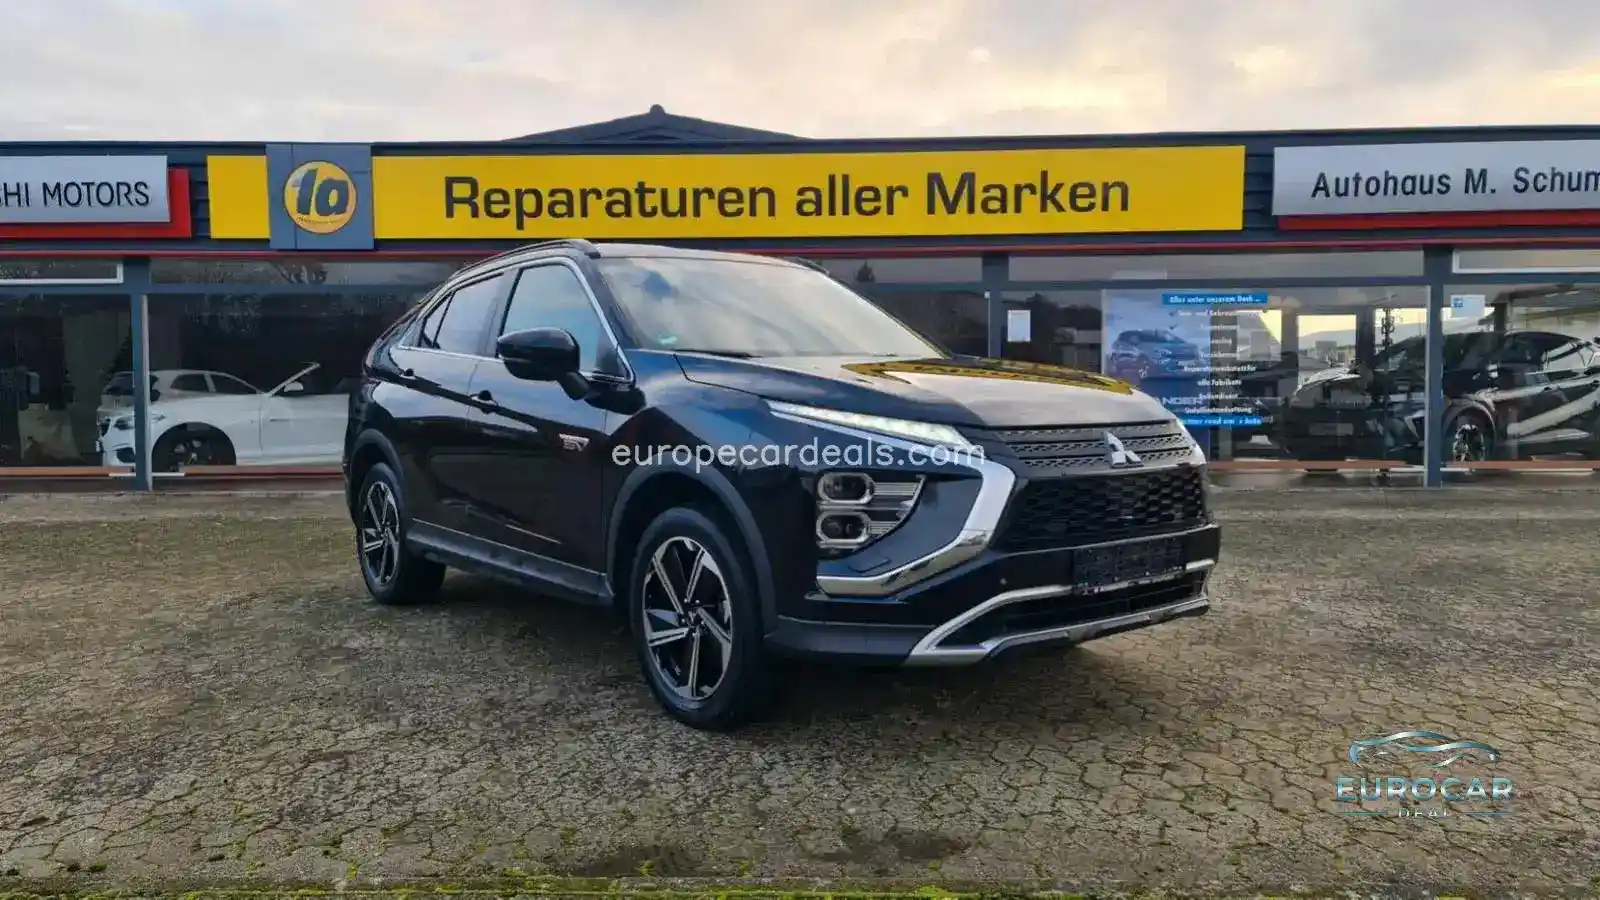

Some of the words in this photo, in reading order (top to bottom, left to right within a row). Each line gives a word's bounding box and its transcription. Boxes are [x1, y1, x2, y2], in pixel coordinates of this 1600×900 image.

[0, 181, 30, 207] HI
[42, 180, 150, 207] MOTORS
[1311, 170, 1451, 198] Autohaus
[1464, 167, 1496, 194] M.
[444, 175, 776, 230] Reparaturen
[796, 174, 909, 217] aller
[926, 168, 1129, 215] Marken
